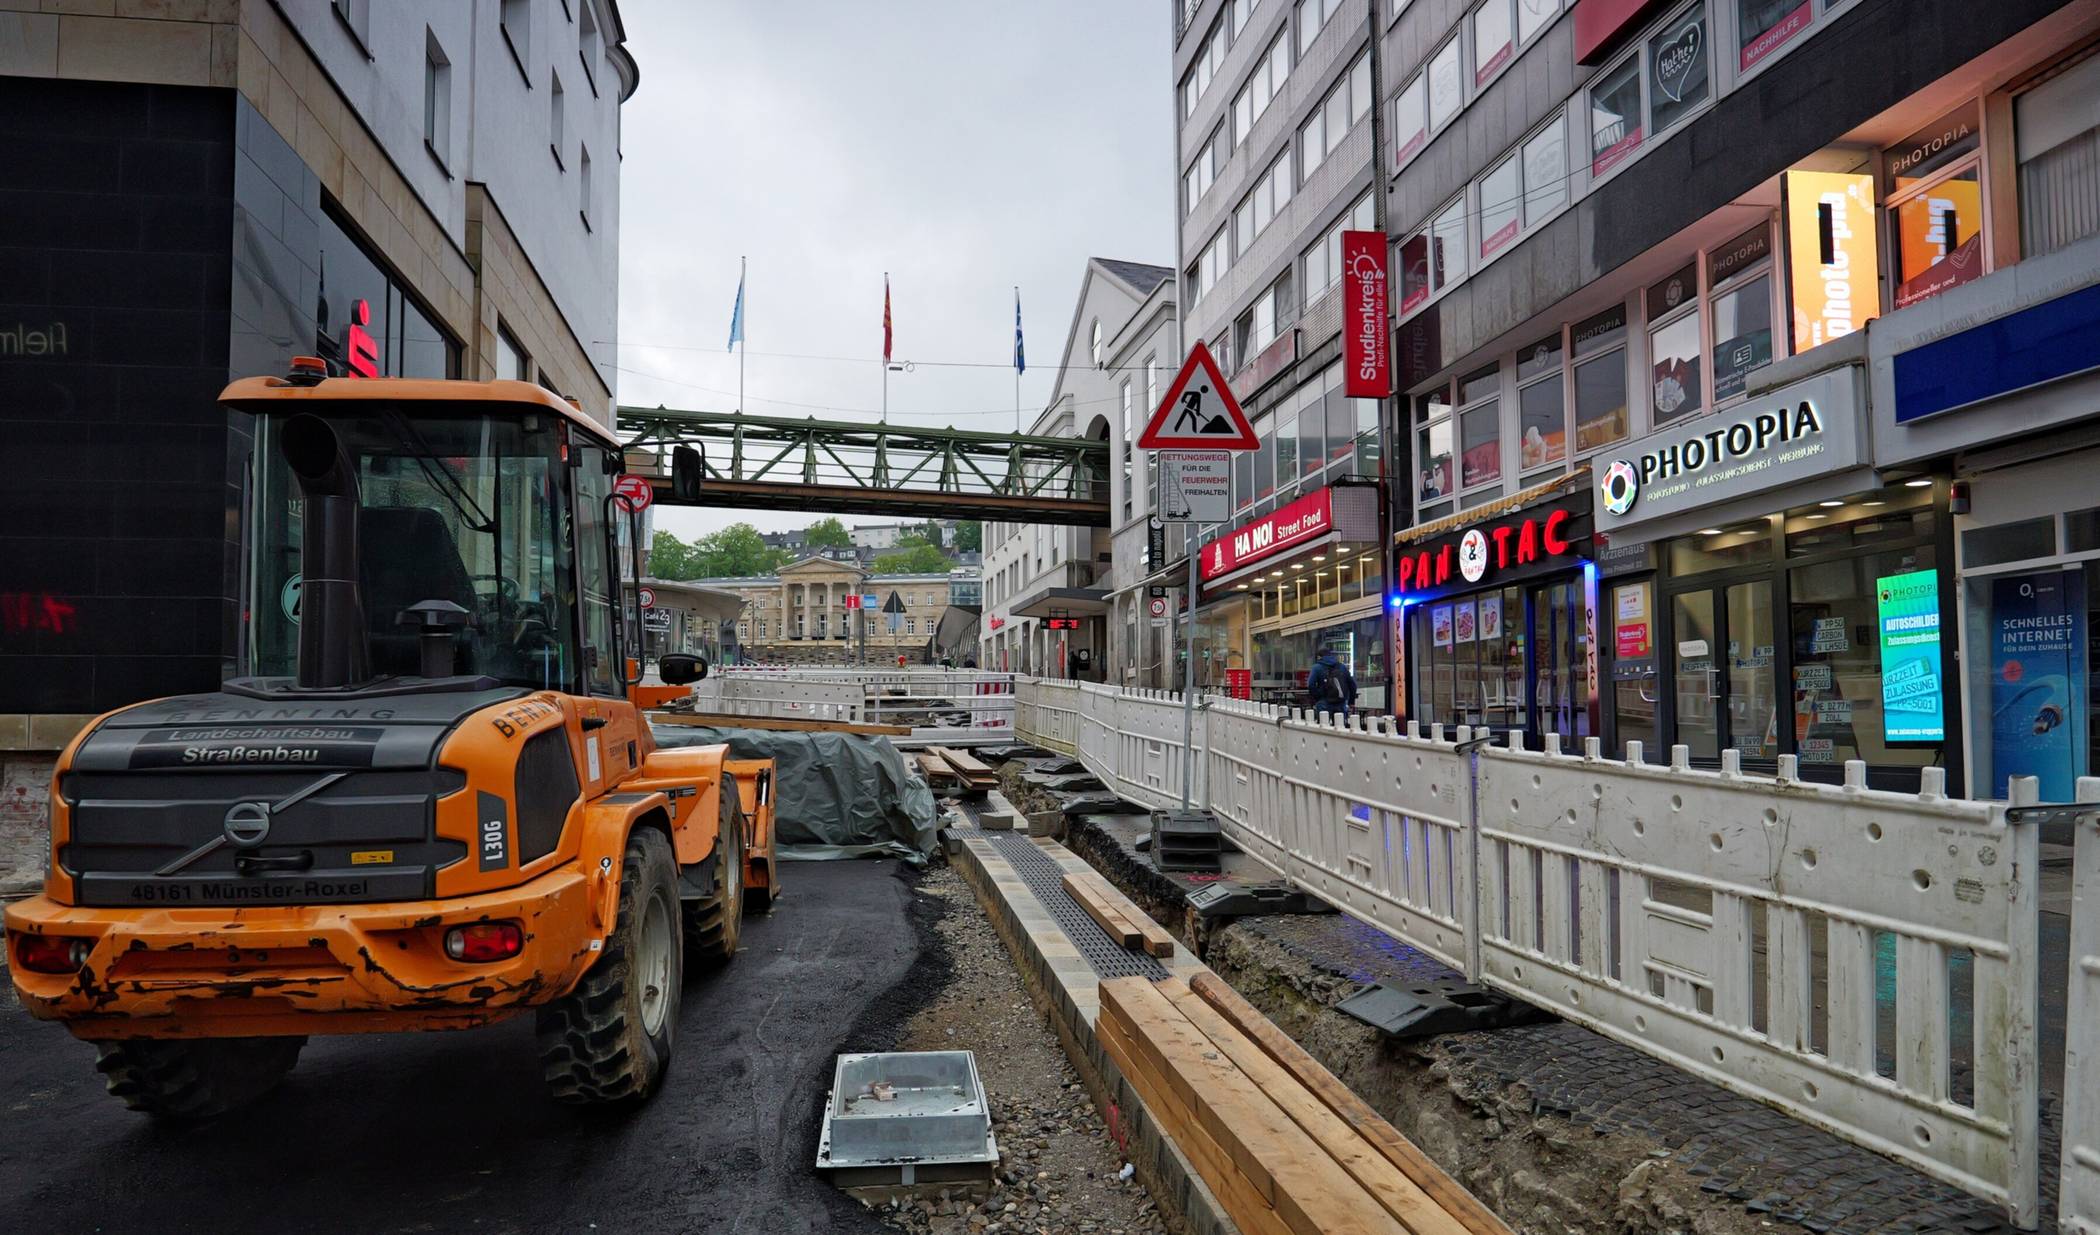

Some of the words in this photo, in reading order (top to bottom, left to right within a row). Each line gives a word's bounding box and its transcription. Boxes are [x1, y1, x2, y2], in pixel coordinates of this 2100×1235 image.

[1746, 17, 1800, 61] NACHHILFE
[1891, 124, 1969, 176] PHOTOPIA
[1712, 239, 1765, 274] PHOTOPIA
[1896, 280, 1940, 306] Professioneller
[1942, 276, 1956, 289] und
[1359, 270, 1377, 381] Studienkreis
[1376, 311, 1385, 368] Profi-Nachhilfe
[1641, 401, 1821, 485] PHOTOPIA
[1160, 453, 1229, 462] RETTUNGSWEGE
[1182, 464, 1197, 472] FÜR
[1182, 476, 1228, 484] FEUERWEHR
[1184, 488, 1228, 496] FREIHALTEN
[1235, 532, 1250, 558] HA
[1252, 521, 1273, 551] NOI
[1277, 519, 1300, 539] Street
[1302, 508, 1321, 529] Food
[1400, 544, 1452, 593] PAN
[1492, 510, 1569, 569] TAC
[644, 612, 659, 620] Café
[2003, 614, 2073, 630] SCHNELLES
[2003, 628, 2073, 643] INTERNET
[2003, 645, 2017, 653] FÜR
[2018, 644, 2036, 652] DEIN
[2038, 642, 2073, 651] ZUHAUSE
[1886, 678, 1935, 700] ZULASSUNG
[165, 708, 395, 722] BENNING
[168, 728, 354, 741] Landschaftsbau
[183, 746, 319, 763] Straßenbau
[484, 820, 503, 861] L30G
[131, 885, 192, 900] 48161
[202, 880, 369, 900] Münster-Roxel
